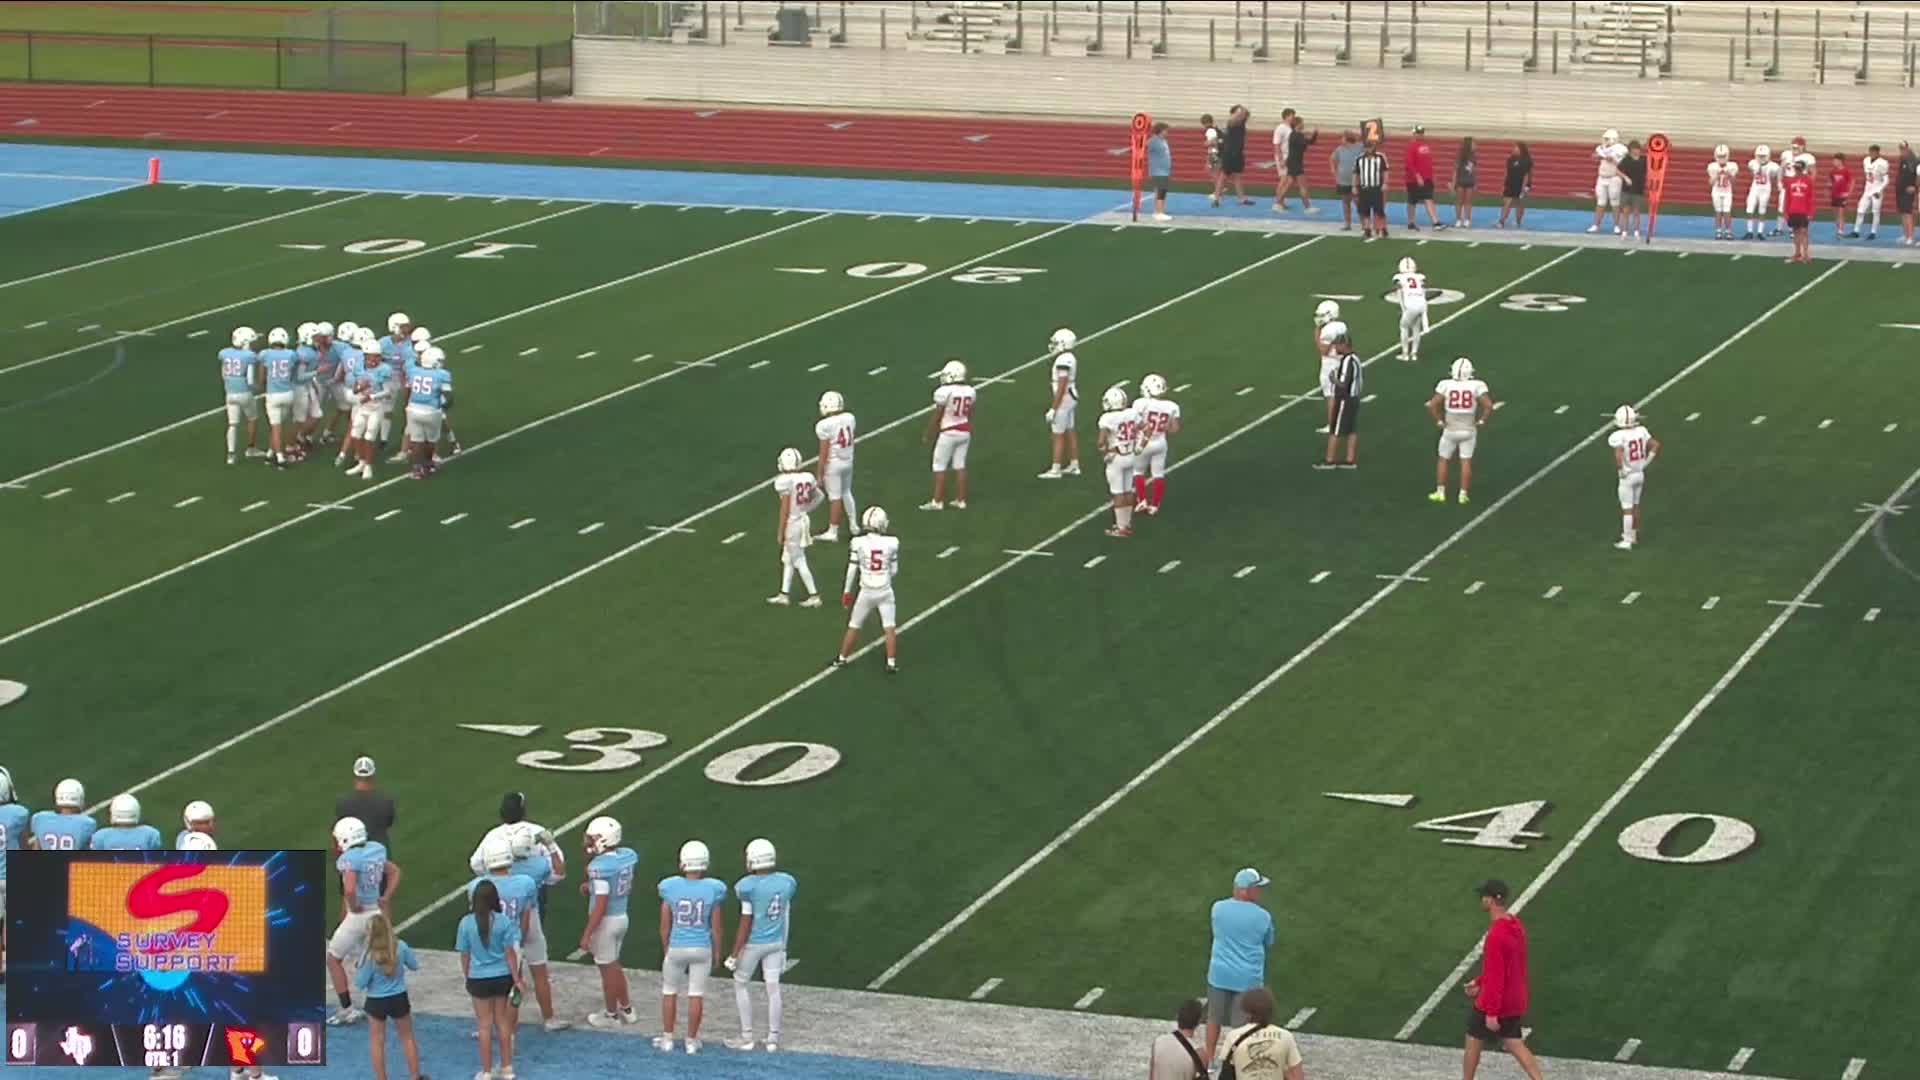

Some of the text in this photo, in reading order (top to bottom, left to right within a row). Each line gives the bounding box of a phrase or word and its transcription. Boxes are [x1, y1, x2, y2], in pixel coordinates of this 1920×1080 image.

[271, 359, 289, 378] 15
[412, 375, 433, 395] 65
[952, 396, 972, 417] 76
[1448, 389, 1474, 409] 28
[1147, 411, 1170, 433] 52
[836, 425, 854, 449] 41
[1629, 439, 1647, 462] 21
[870, 549, 884, 572] 5
[675, 897, 706, 927] 21
[767, 893, 782, 923] 4
